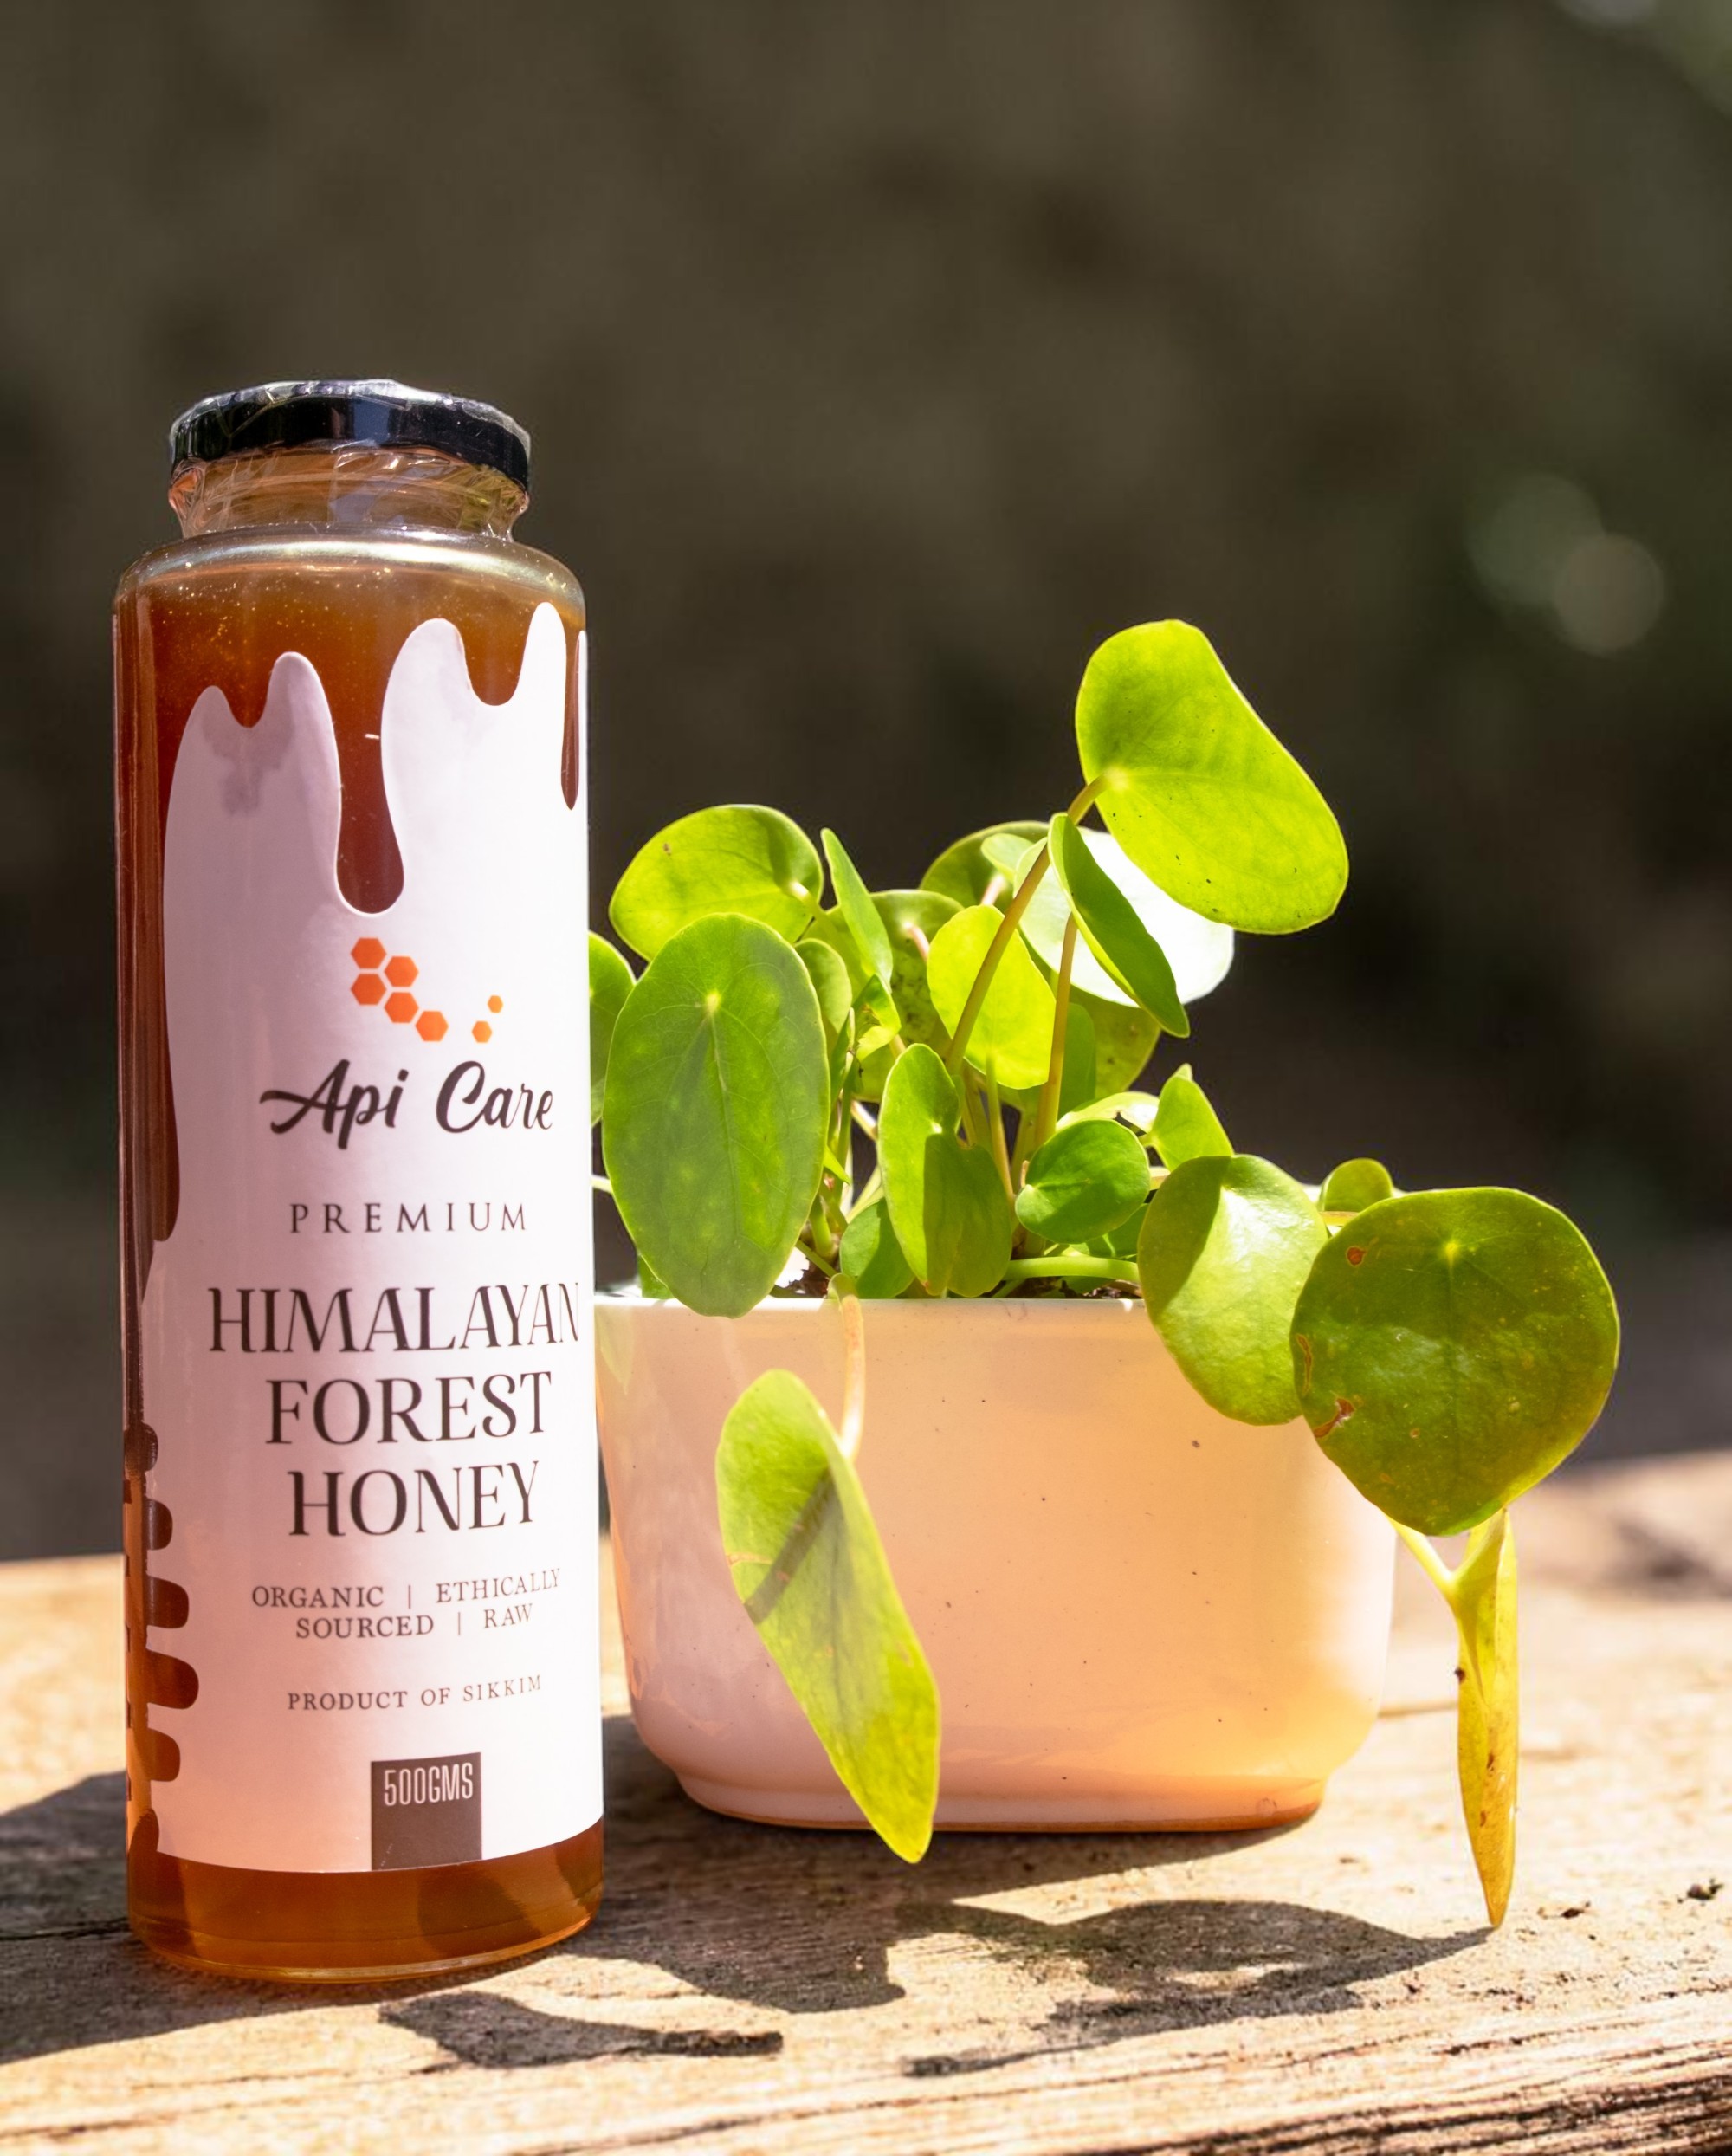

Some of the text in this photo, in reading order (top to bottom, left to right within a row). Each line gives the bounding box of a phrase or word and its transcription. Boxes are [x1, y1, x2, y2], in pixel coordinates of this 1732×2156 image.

[259, 1059, 553, 1149] Api Care
[289, 1201, 526, 1233] PREMIUM
[208, 1282, 578, 1353] HIMALAYAN
[265, 1370, 553, 1445] FOREST
[288, 1460, 539, 1536] HONEY
[251, 1584, 385, 1609] ORGANIC
[436, 1568, 560, 1604] ETHICALLY
[295, 1614, 435, 1640] SOURCED
[482, 1603, 533, 1629] RAW
[287, 1675, 541, 1711] PRODUCT OF SIKKIM
[384, 1762, 474, 1807] 500GMS
